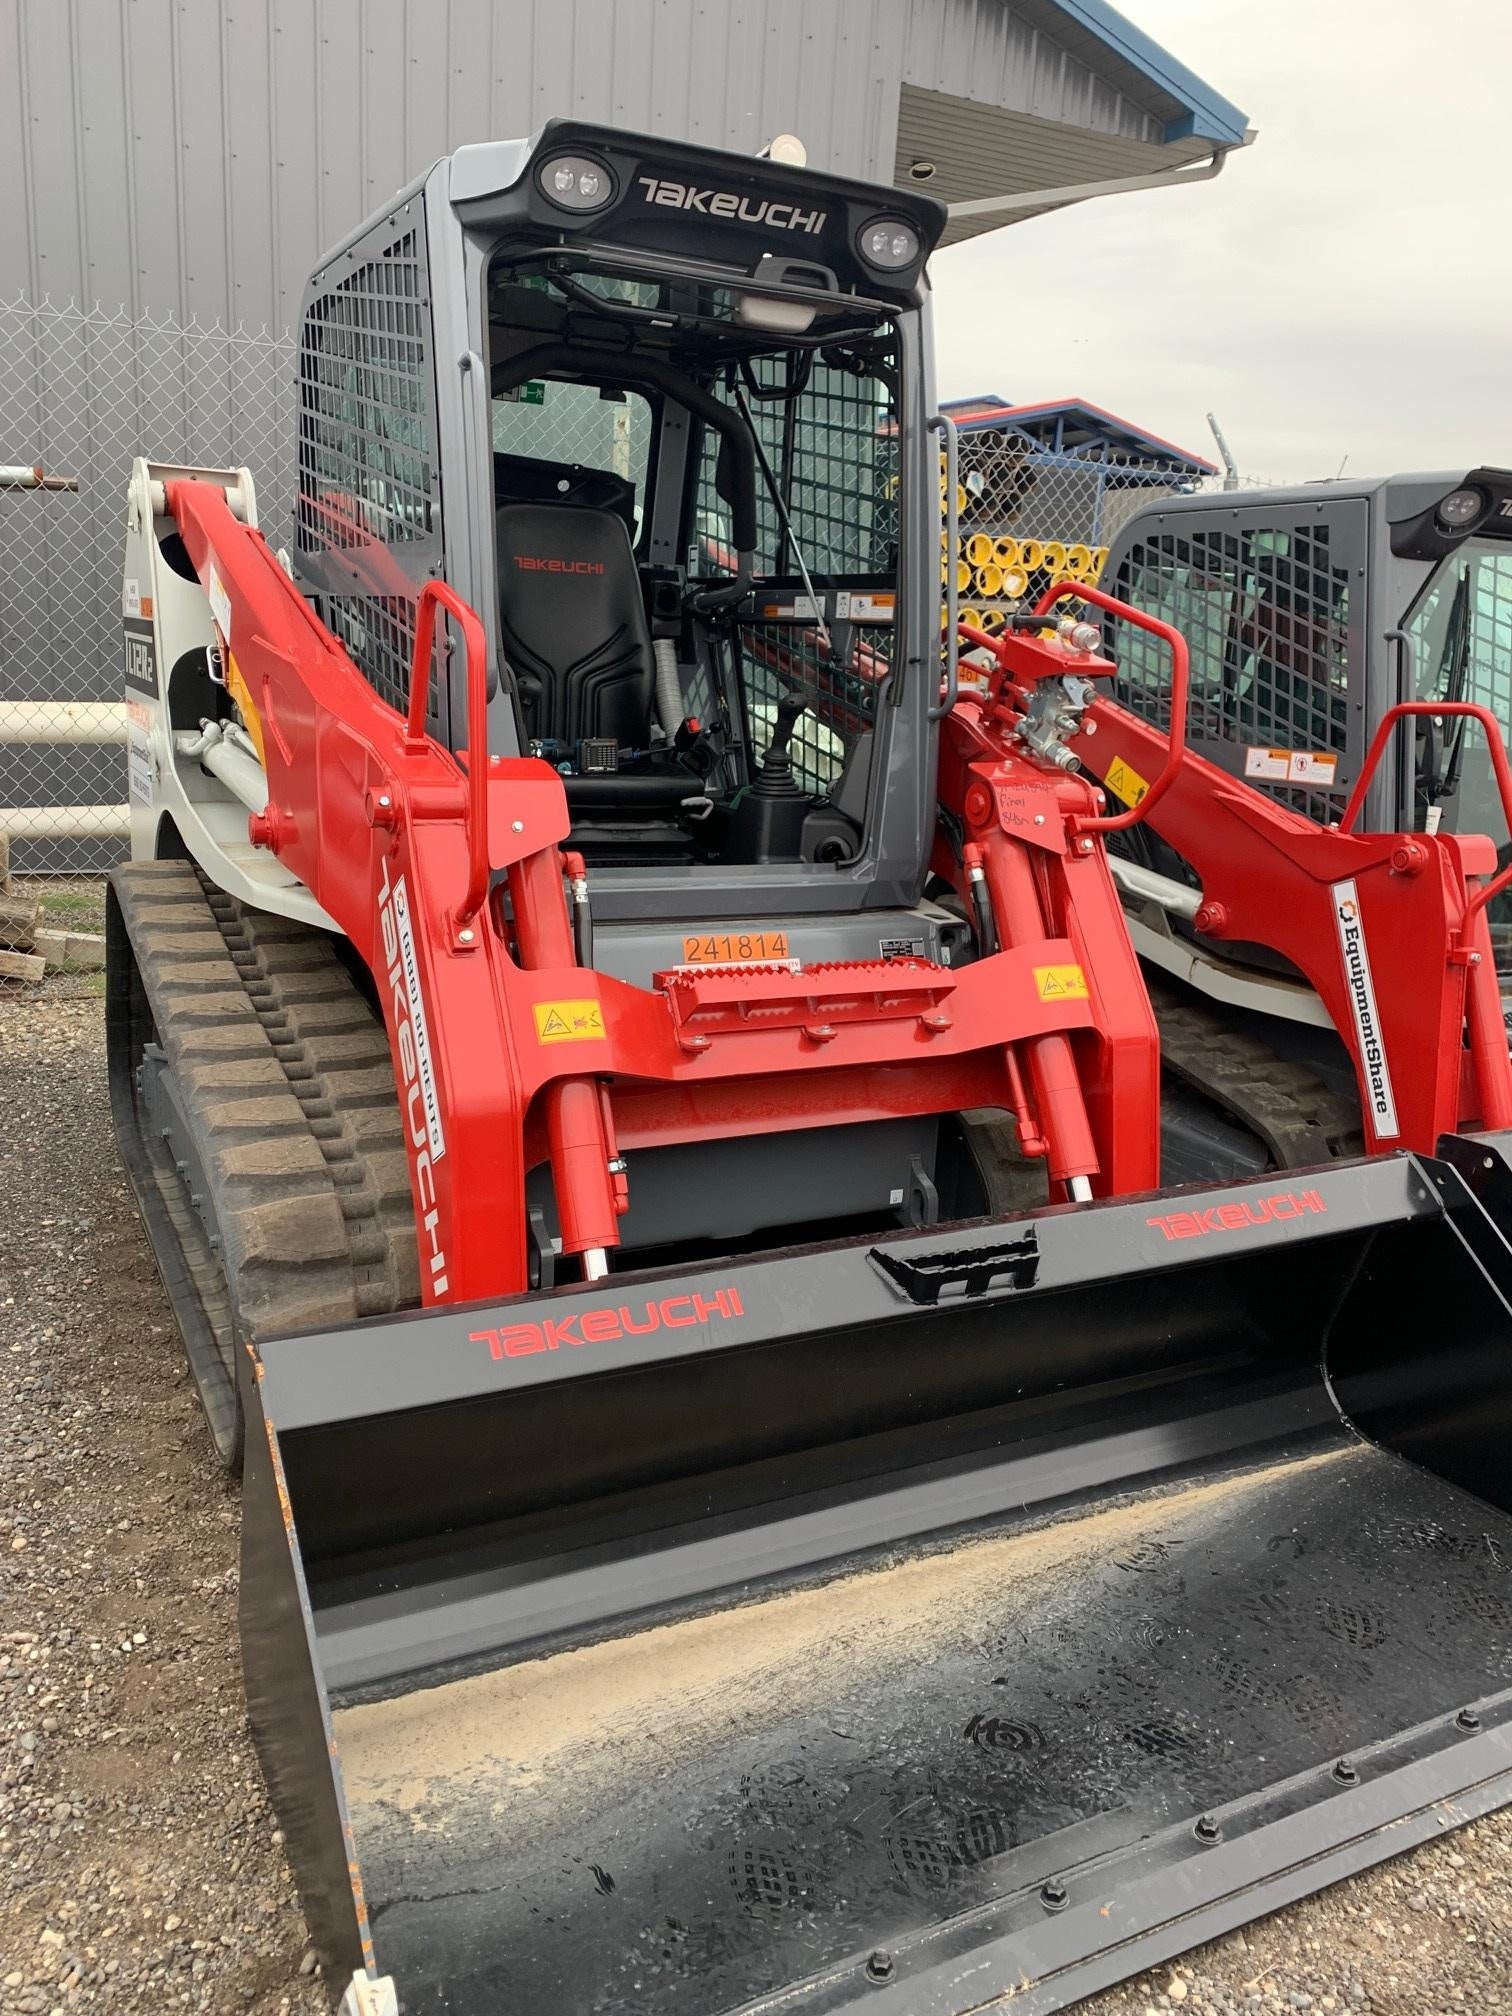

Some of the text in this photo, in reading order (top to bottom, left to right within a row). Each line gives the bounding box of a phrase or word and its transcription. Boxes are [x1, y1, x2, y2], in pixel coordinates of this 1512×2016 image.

[639, 177, 827, 234] TAKEUCHI
[513, 556, 604, 574] TAKEUCHI
[687, 933, 787, 962] 241814
[1345, 925, 1388, 1115] EquipmentShare
[1146, 1190, 1328, 1241] TAKEUCHI
[469, 1288, 744, 1361] TAKEUCHI
